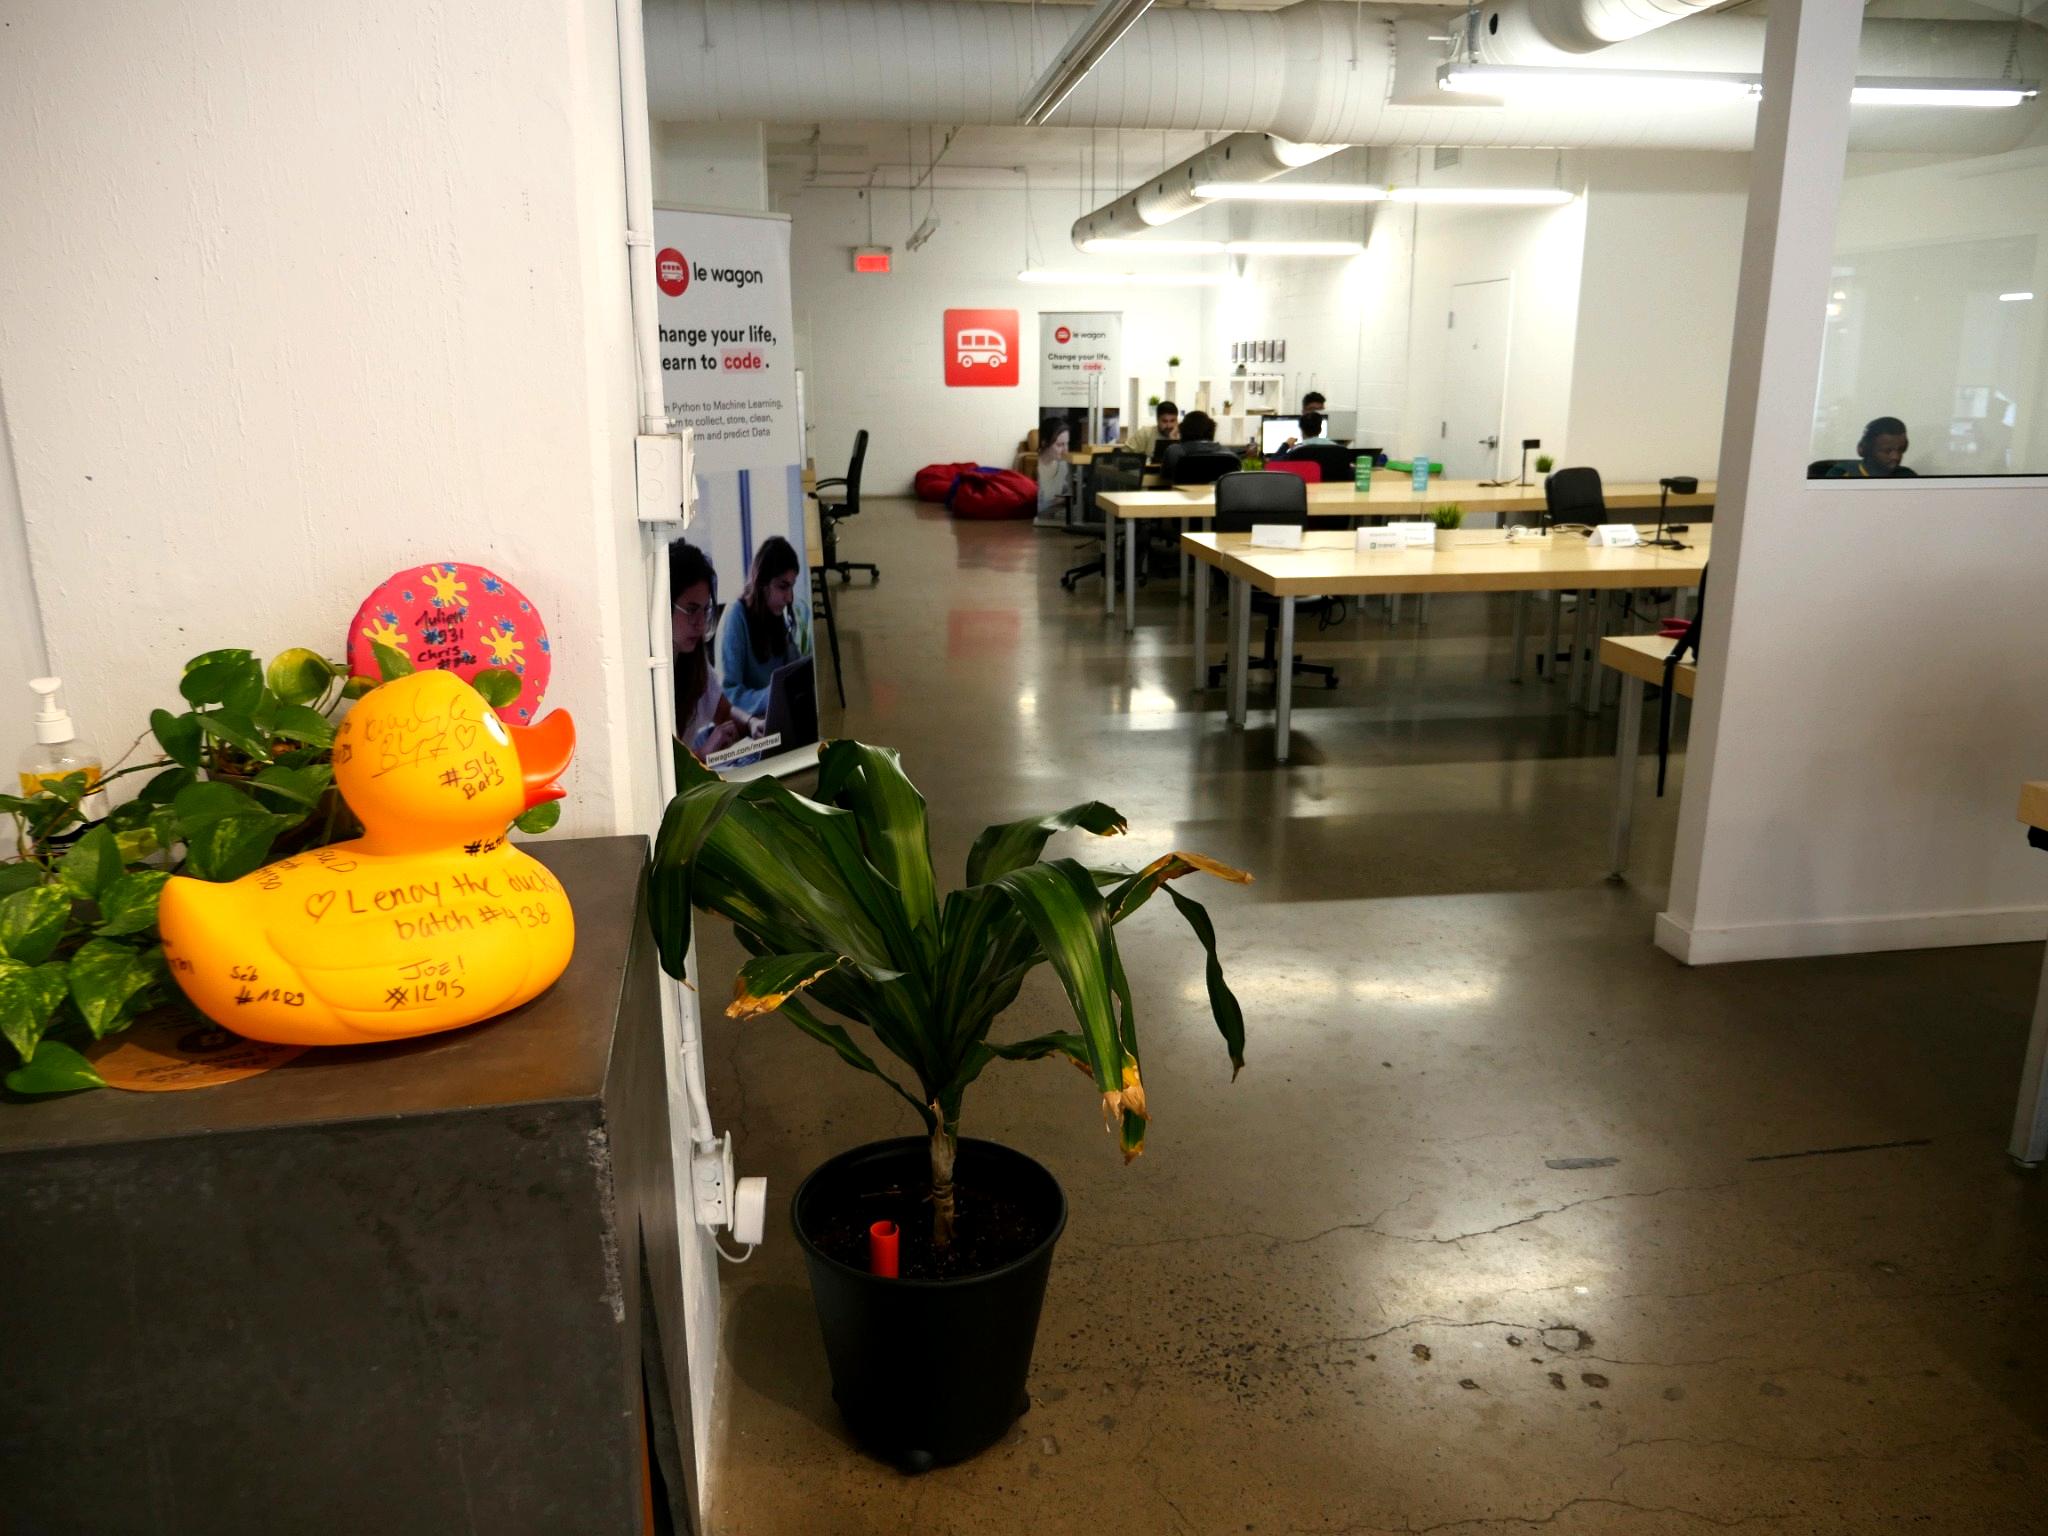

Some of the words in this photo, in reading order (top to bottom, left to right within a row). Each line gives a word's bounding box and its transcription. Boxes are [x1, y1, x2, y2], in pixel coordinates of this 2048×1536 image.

[692, 262, 707, 281] le
[711, 267, 763, 288] wagon
[658, 324, 707, 347] hange
[711, 327, 745, 346] your
[749, 325, 777, 346] life,
[662, 357, 697, 371] earn
[700, 354, 717, 370] to
[1047, 353, 1076, 362] Change
[672, 402, 701, 414] Python
[703, 402, 712, 412] to
[713, 399, 746, 411] Machine
[748, 398, 784, 410] Learning,
[685, 417, 694, 427] to
[696, 415, 725, 426] collect,
[749, 413, 774, 424] clean,
[706, 430, 722, 441] and
[723, 427, 750, 441] predict
[751, 427, 771, 438] Data
[394, 909, 475, 940] batch
